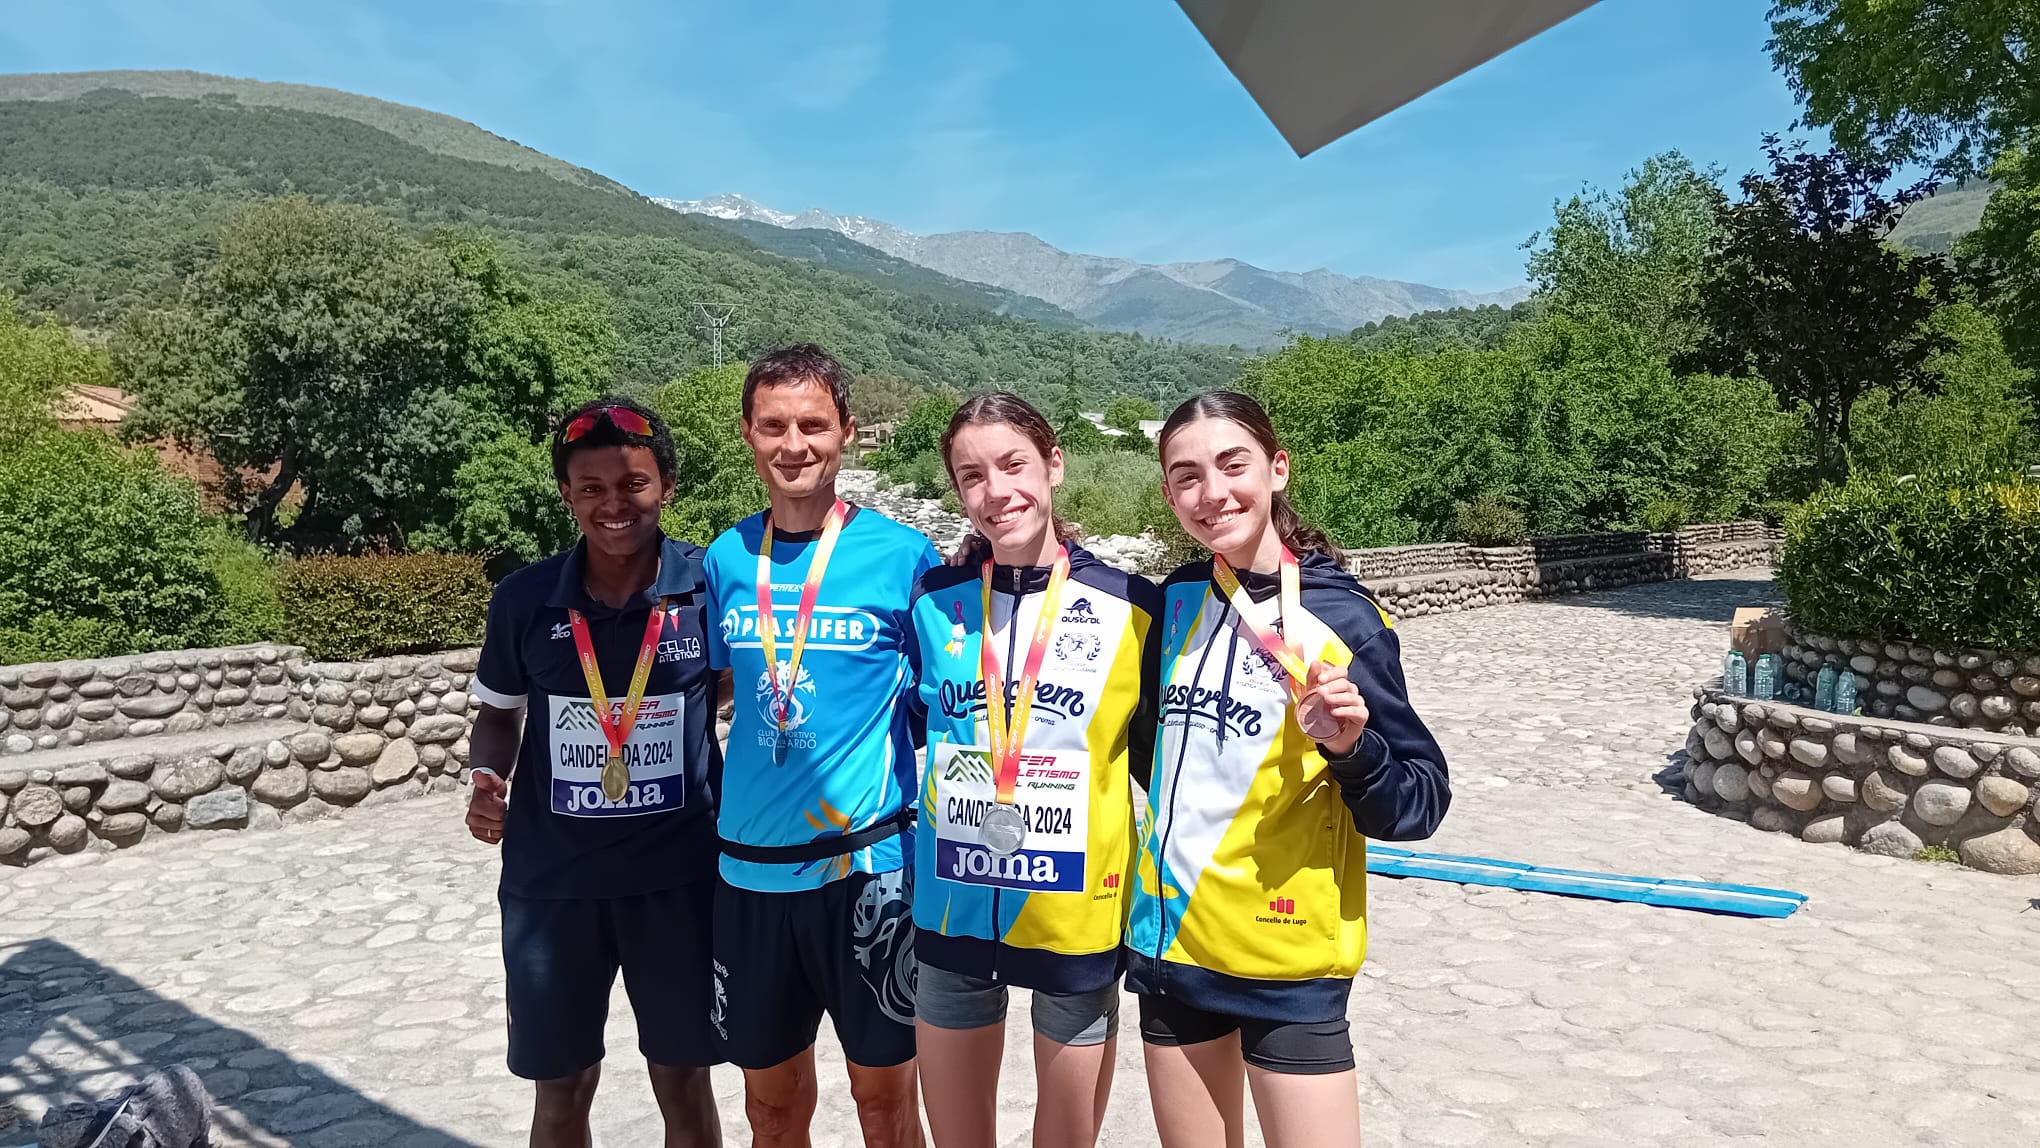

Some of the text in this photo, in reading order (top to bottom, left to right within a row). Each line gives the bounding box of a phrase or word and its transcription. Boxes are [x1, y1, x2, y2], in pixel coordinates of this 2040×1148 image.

[742, 617, 864, 640] PLASIFER
[657, 637, 701, 655] CELTA
[611, 701, 660, 711] REA
[560, 740, 673, 768] CANDELDA 2024
[1018, 755, 1057, 766] FEA
[1027, 781, 1076, 791] RUNNING
[1035, 806, 1072, 834] 2024
[1255, 915, 1282, 924] Concello
[1292, 918, 1307, 926] Lugo
